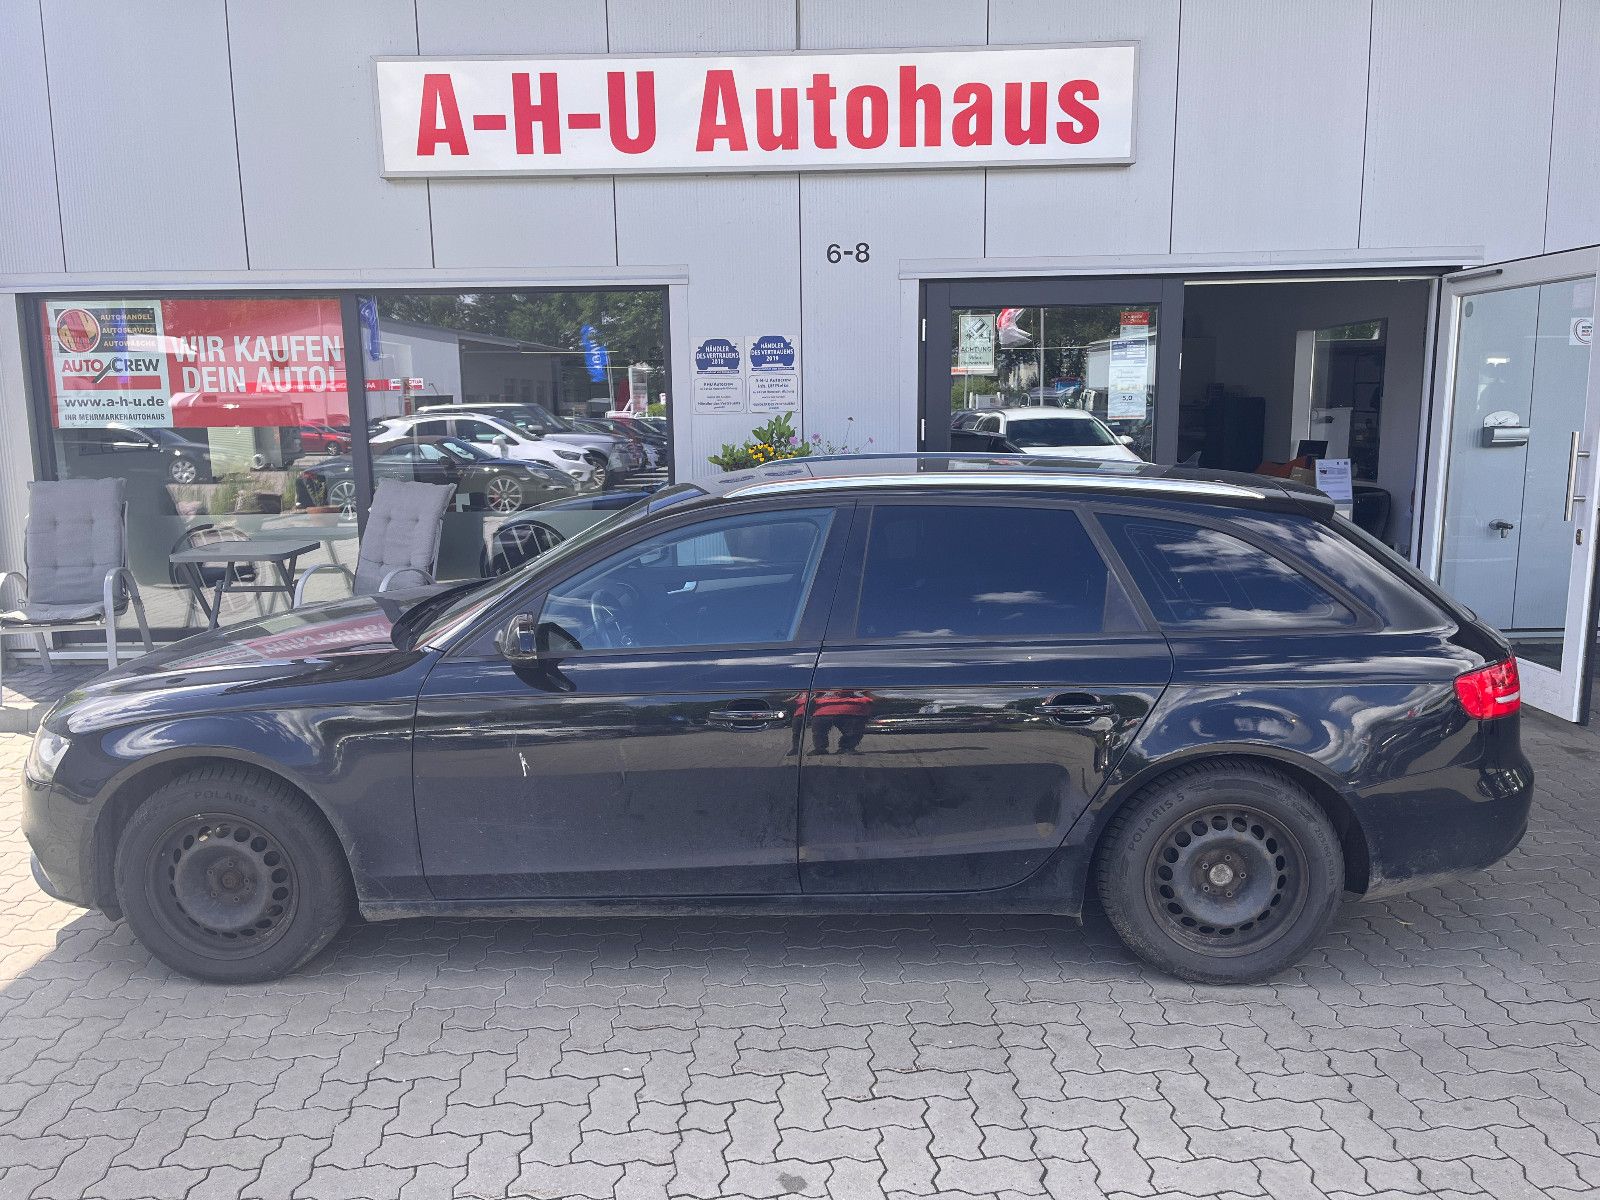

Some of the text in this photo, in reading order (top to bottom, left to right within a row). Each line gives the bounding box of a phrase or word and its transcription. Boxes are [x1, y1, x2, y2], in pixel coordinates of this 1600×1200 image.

[416, 65, 1100, 156] A-H-U Autohaus
[826, 242, 870, 263] 6-8
[100, 313, 153, 321] AUTOHANDEL
[173, 335, 342, 363] WIR KAUFEN
[760, 341, 784, 349] HÄNDLER
[62, 358, 160, 373] AUTO CREW
[182, 366, 338, 393] DEIN AUTO!
[64, 397, 165, 407] www.a-h-u.de
[79, 413, 166, 421] MEHRMARKENAUTOHAUS
[1127, 800, 1174, 852] POLARIS
